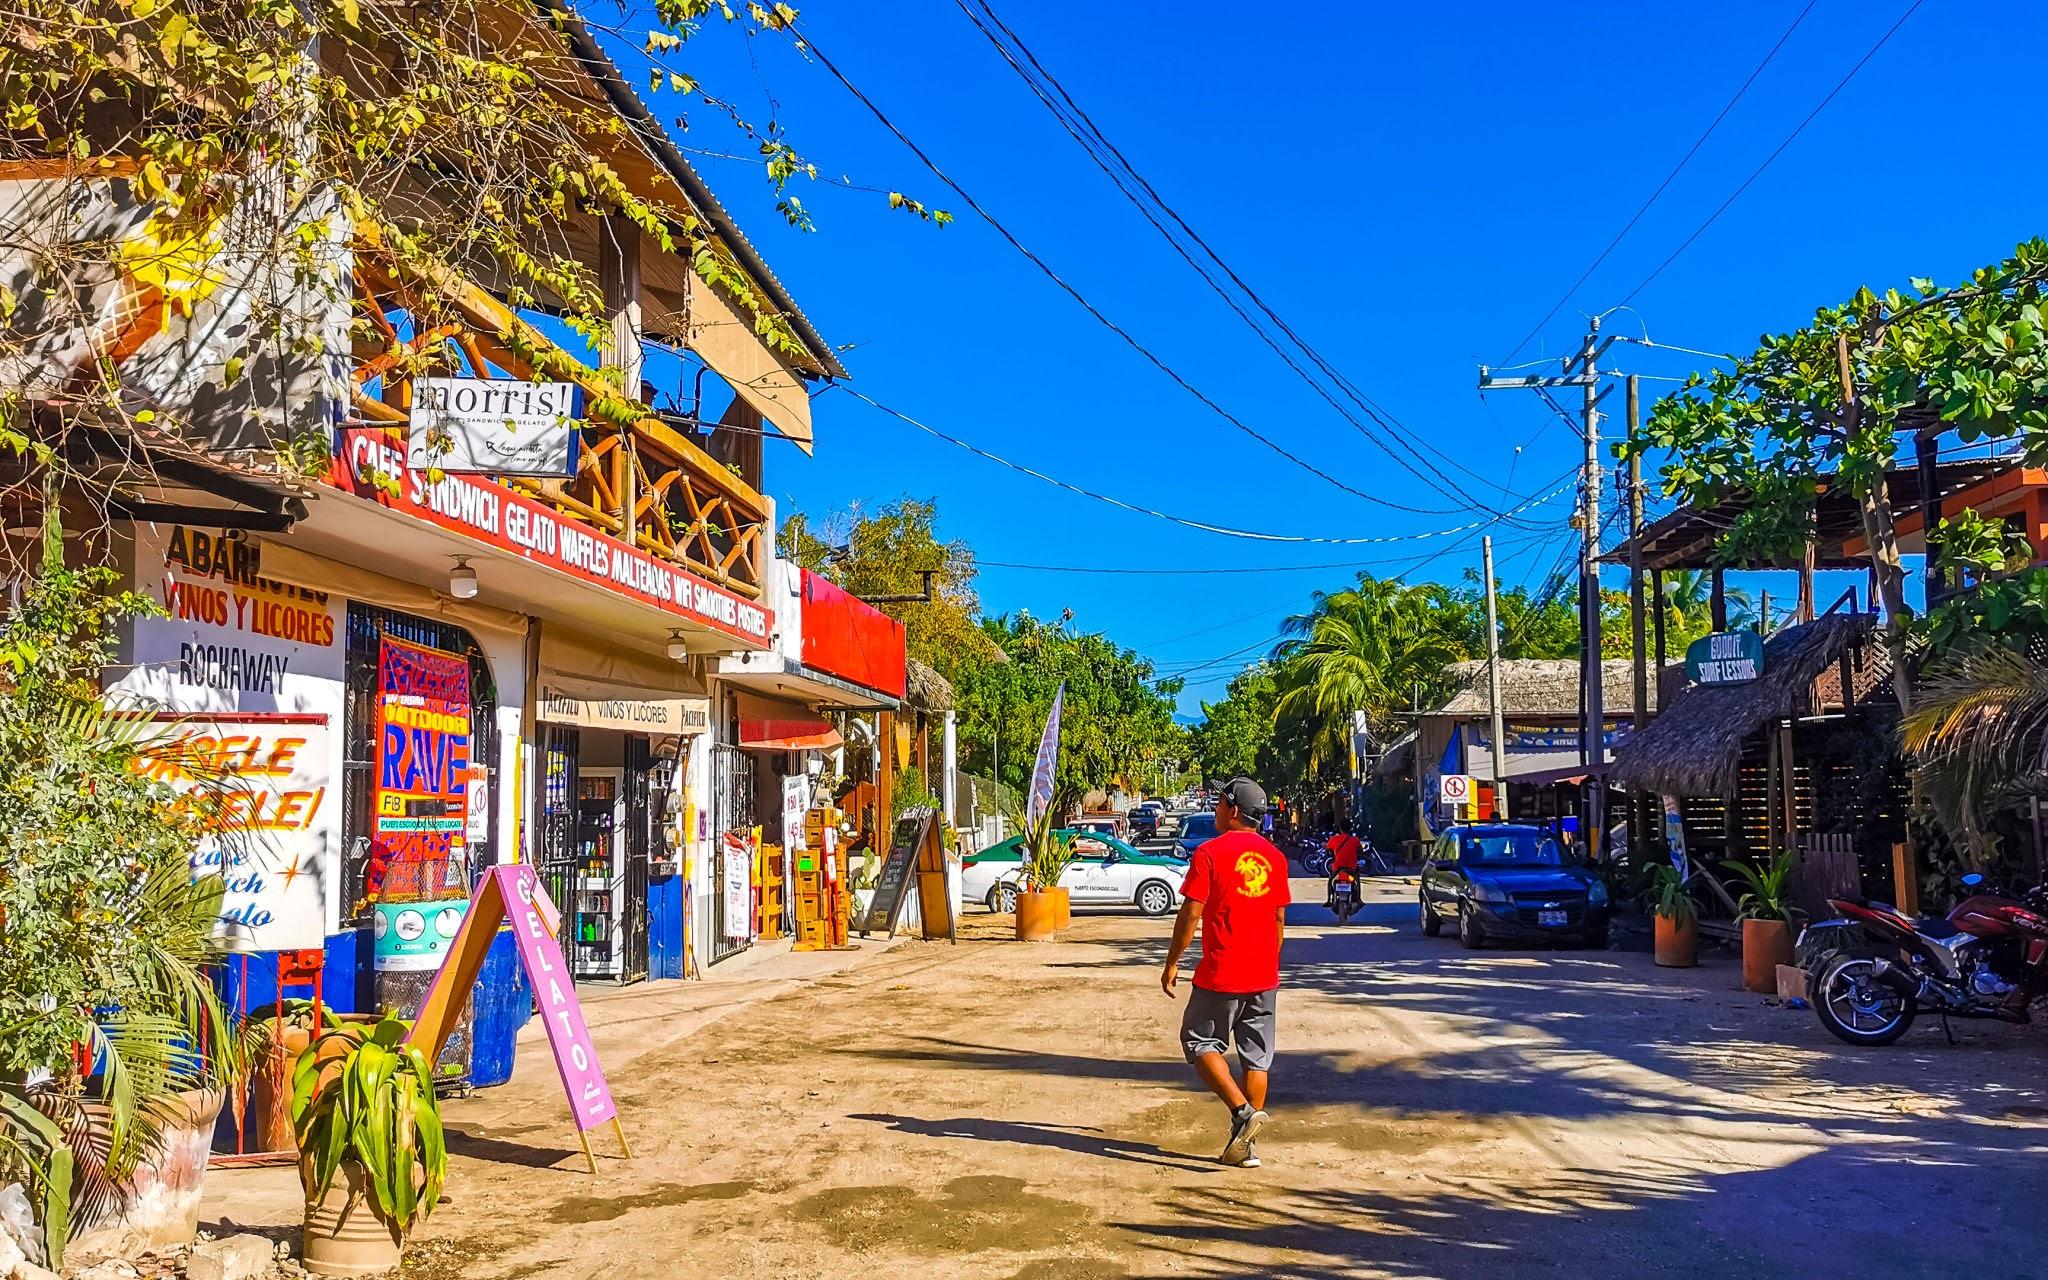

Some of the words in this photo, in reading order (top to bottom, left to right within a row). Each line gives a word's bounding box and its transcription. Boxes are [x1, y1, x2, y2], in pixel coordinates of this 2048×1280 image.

[416, 383, 567, 417] morris!
[410, 468, 499, 534] SANDWICH
[505, 501, 556, 556] GELATO
[559, 523, 609, 577] WAFFLES
[611, 547, 671, 602] MALTEADAS
[673, 573, 693, 610] WIFI
[738, 602, 766, 638] POSTRES
[162, 578, 229, 627] VINOS
[233, 592, 249, 631] Y
[251, 598, 334, 647] LICORES
[180, 642, 288, 695] ROCKAWAY
[1698, 661, 1721, 683] SURF
[384, 703, 469, 736] OUTDOOR
[598, 700, 625, 720] VINOS
[626, 703, 633, 721] Y
[633, 705, 668, 725] LICORES
[681, 704, 706, 732] PACIFICO
[381, 723, 469, 795] RAVE
[515, 874, 589, 1073] GELATO
